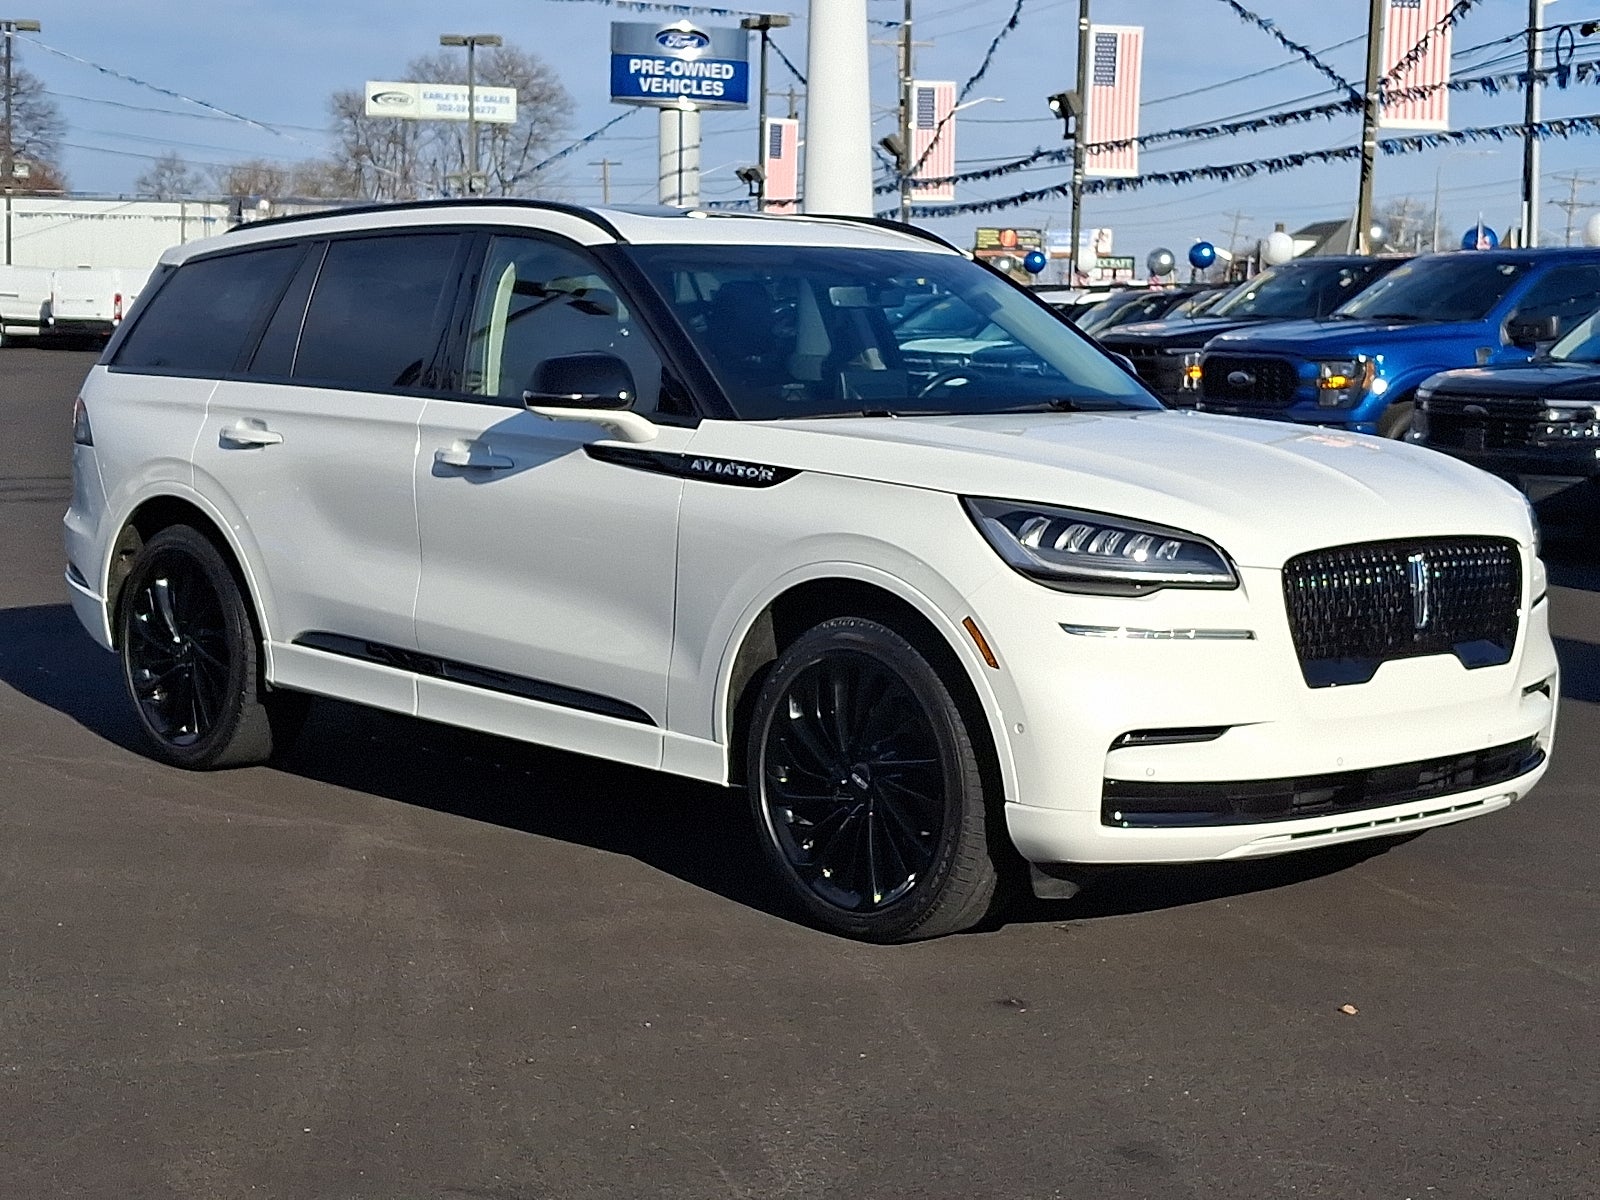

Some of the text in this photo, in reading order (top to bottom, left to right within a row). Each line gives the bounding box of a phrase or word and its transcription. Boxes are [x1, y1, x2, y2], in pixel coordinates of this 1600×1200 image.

[664, 34, 700, 47] Ford
[629, 58, 735, 80] PRE-OWNED
[638, 77, 725, 96] VEHICLES
[483, 95, 511, 104] SALES
[690, 458, 776, 482] AVIATOR
